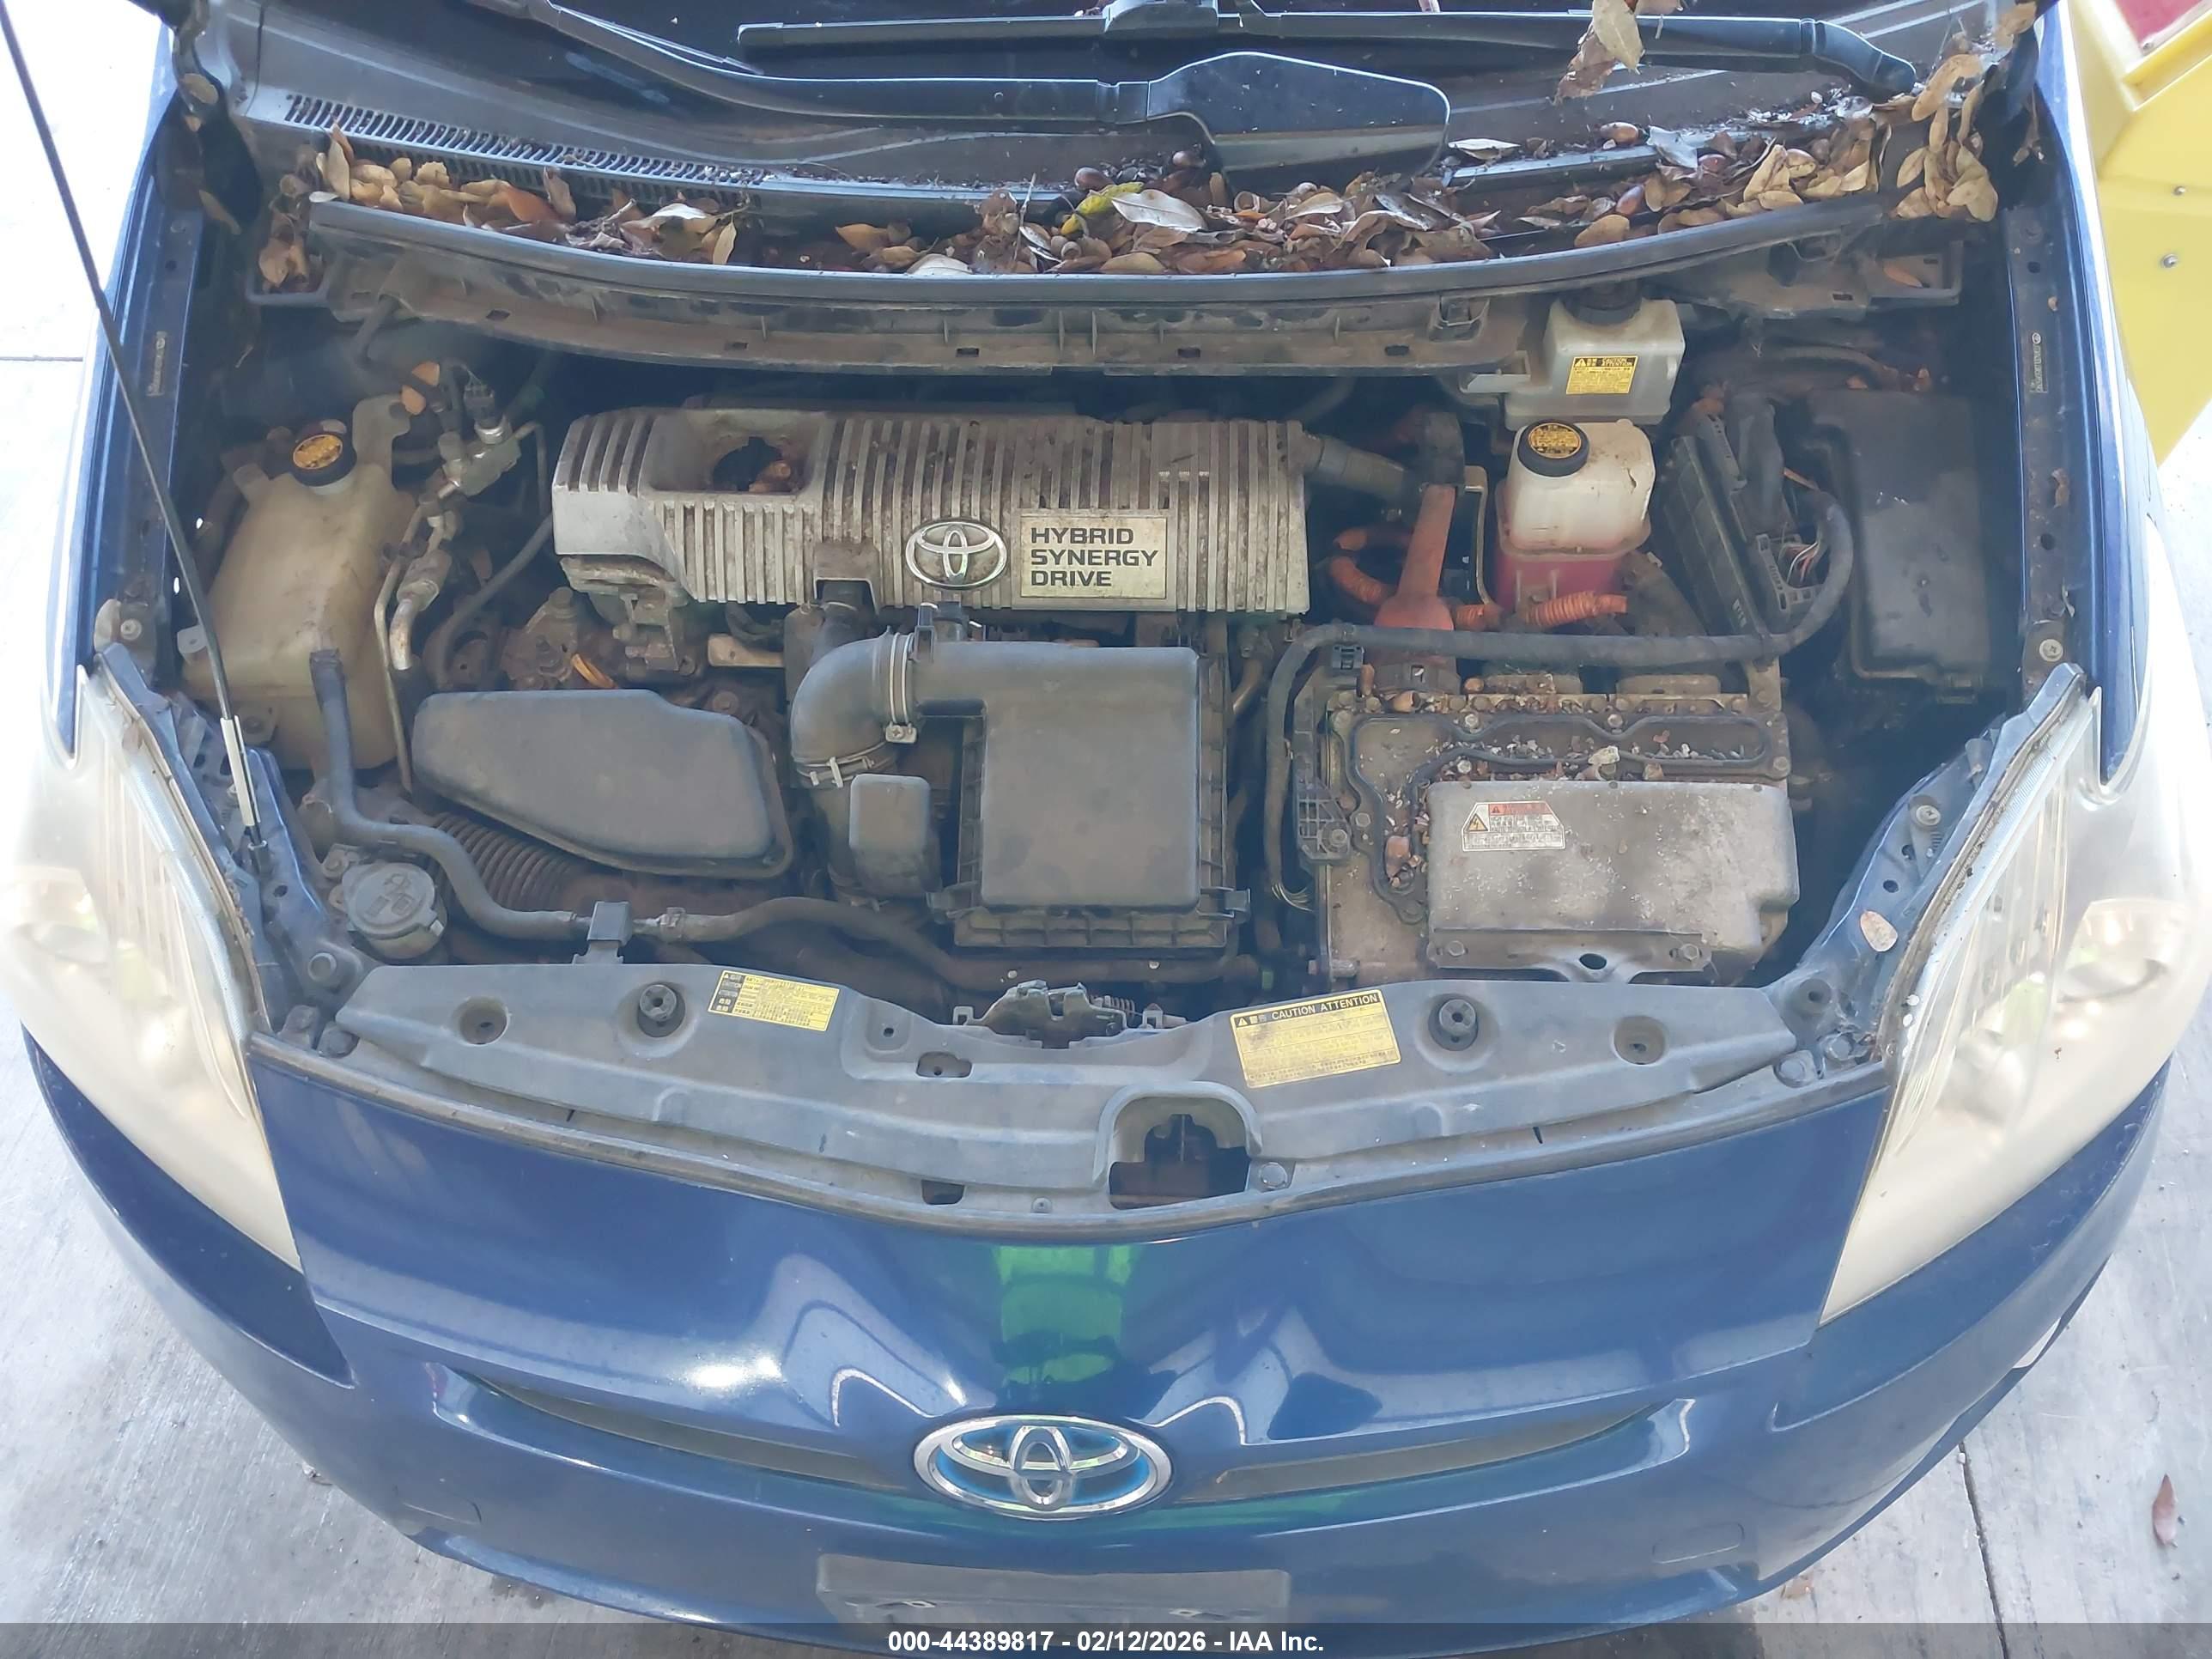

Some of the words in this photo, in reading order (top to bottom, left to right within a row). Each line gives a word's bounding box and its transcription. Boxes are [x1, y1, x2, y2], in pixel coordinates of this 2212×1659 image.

[1031, 527, 1134, 544] HYBRID
[1031, 549, 1158, 567] SYNERGY
[1031, 570, 1112, 586] DRIVE
[1272, 1006, 1316, 1021] CAUTION
[1320, 994, 1378, 1012] ATTENTION
